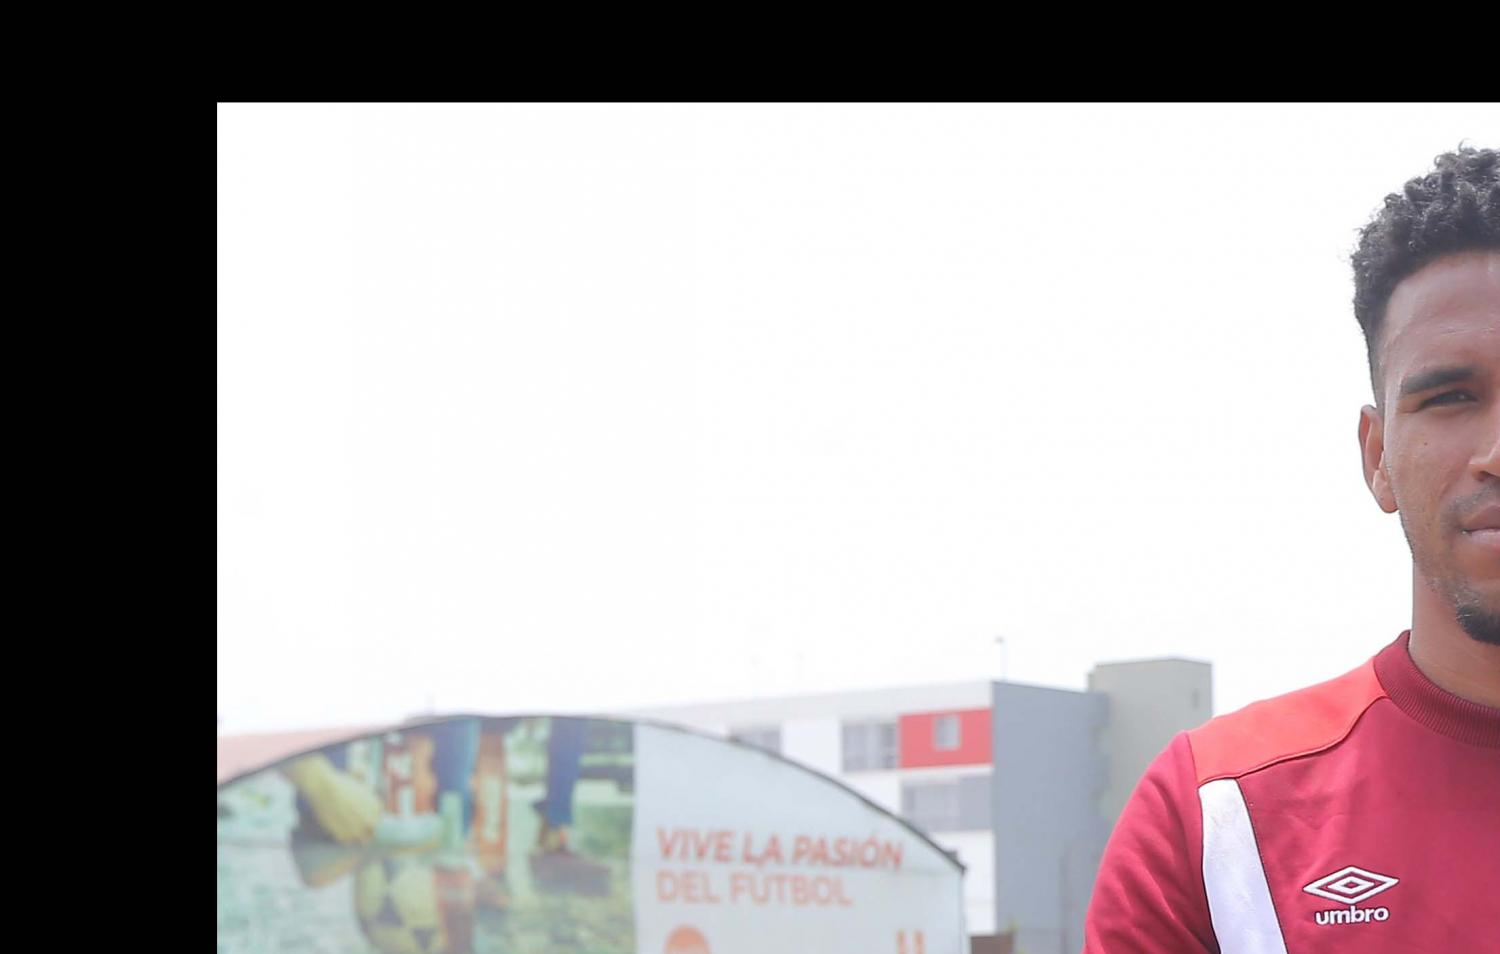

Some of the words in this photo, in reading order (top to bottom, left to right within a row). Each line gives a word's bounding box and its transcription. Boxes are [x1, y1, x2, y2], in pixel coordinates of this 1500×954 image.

[656, 827, 735, 863] VIVE
[743, 831, 784, 865] LA
[791, 834, 905, 870] PASIÓN
[656, 870, 721, 904] DEL
[1315, 905, 1389, 925] umbro
